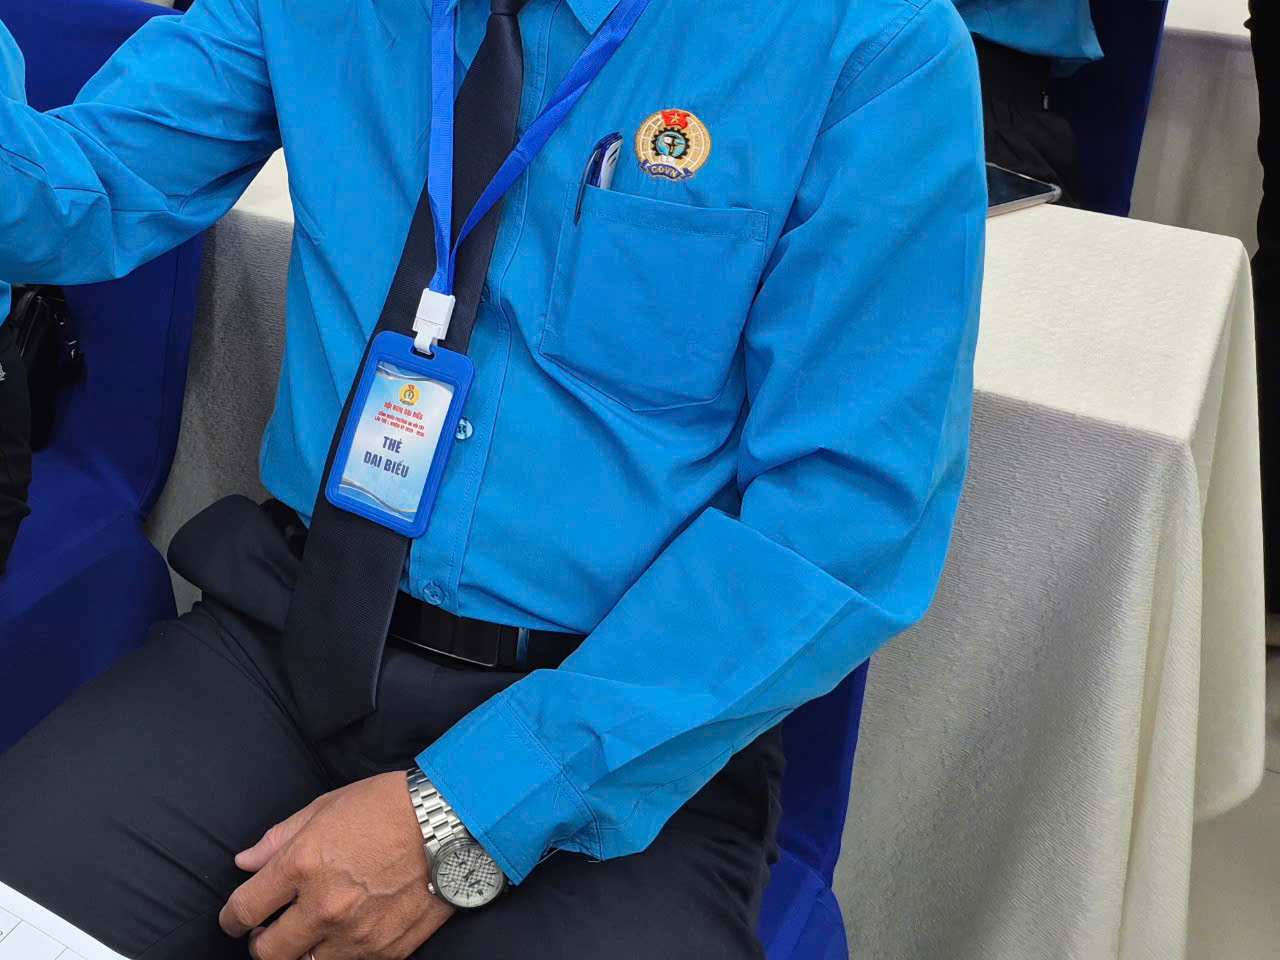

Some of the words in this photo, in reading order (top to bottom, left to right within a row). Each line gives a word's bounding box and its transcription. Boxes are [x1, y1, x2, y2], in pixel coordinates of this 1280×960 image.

[383, 436, 403, 454] THẺ
[364, 451, 382, 469] ĐẠI
[384, 459, 409, 478] BIỂU
